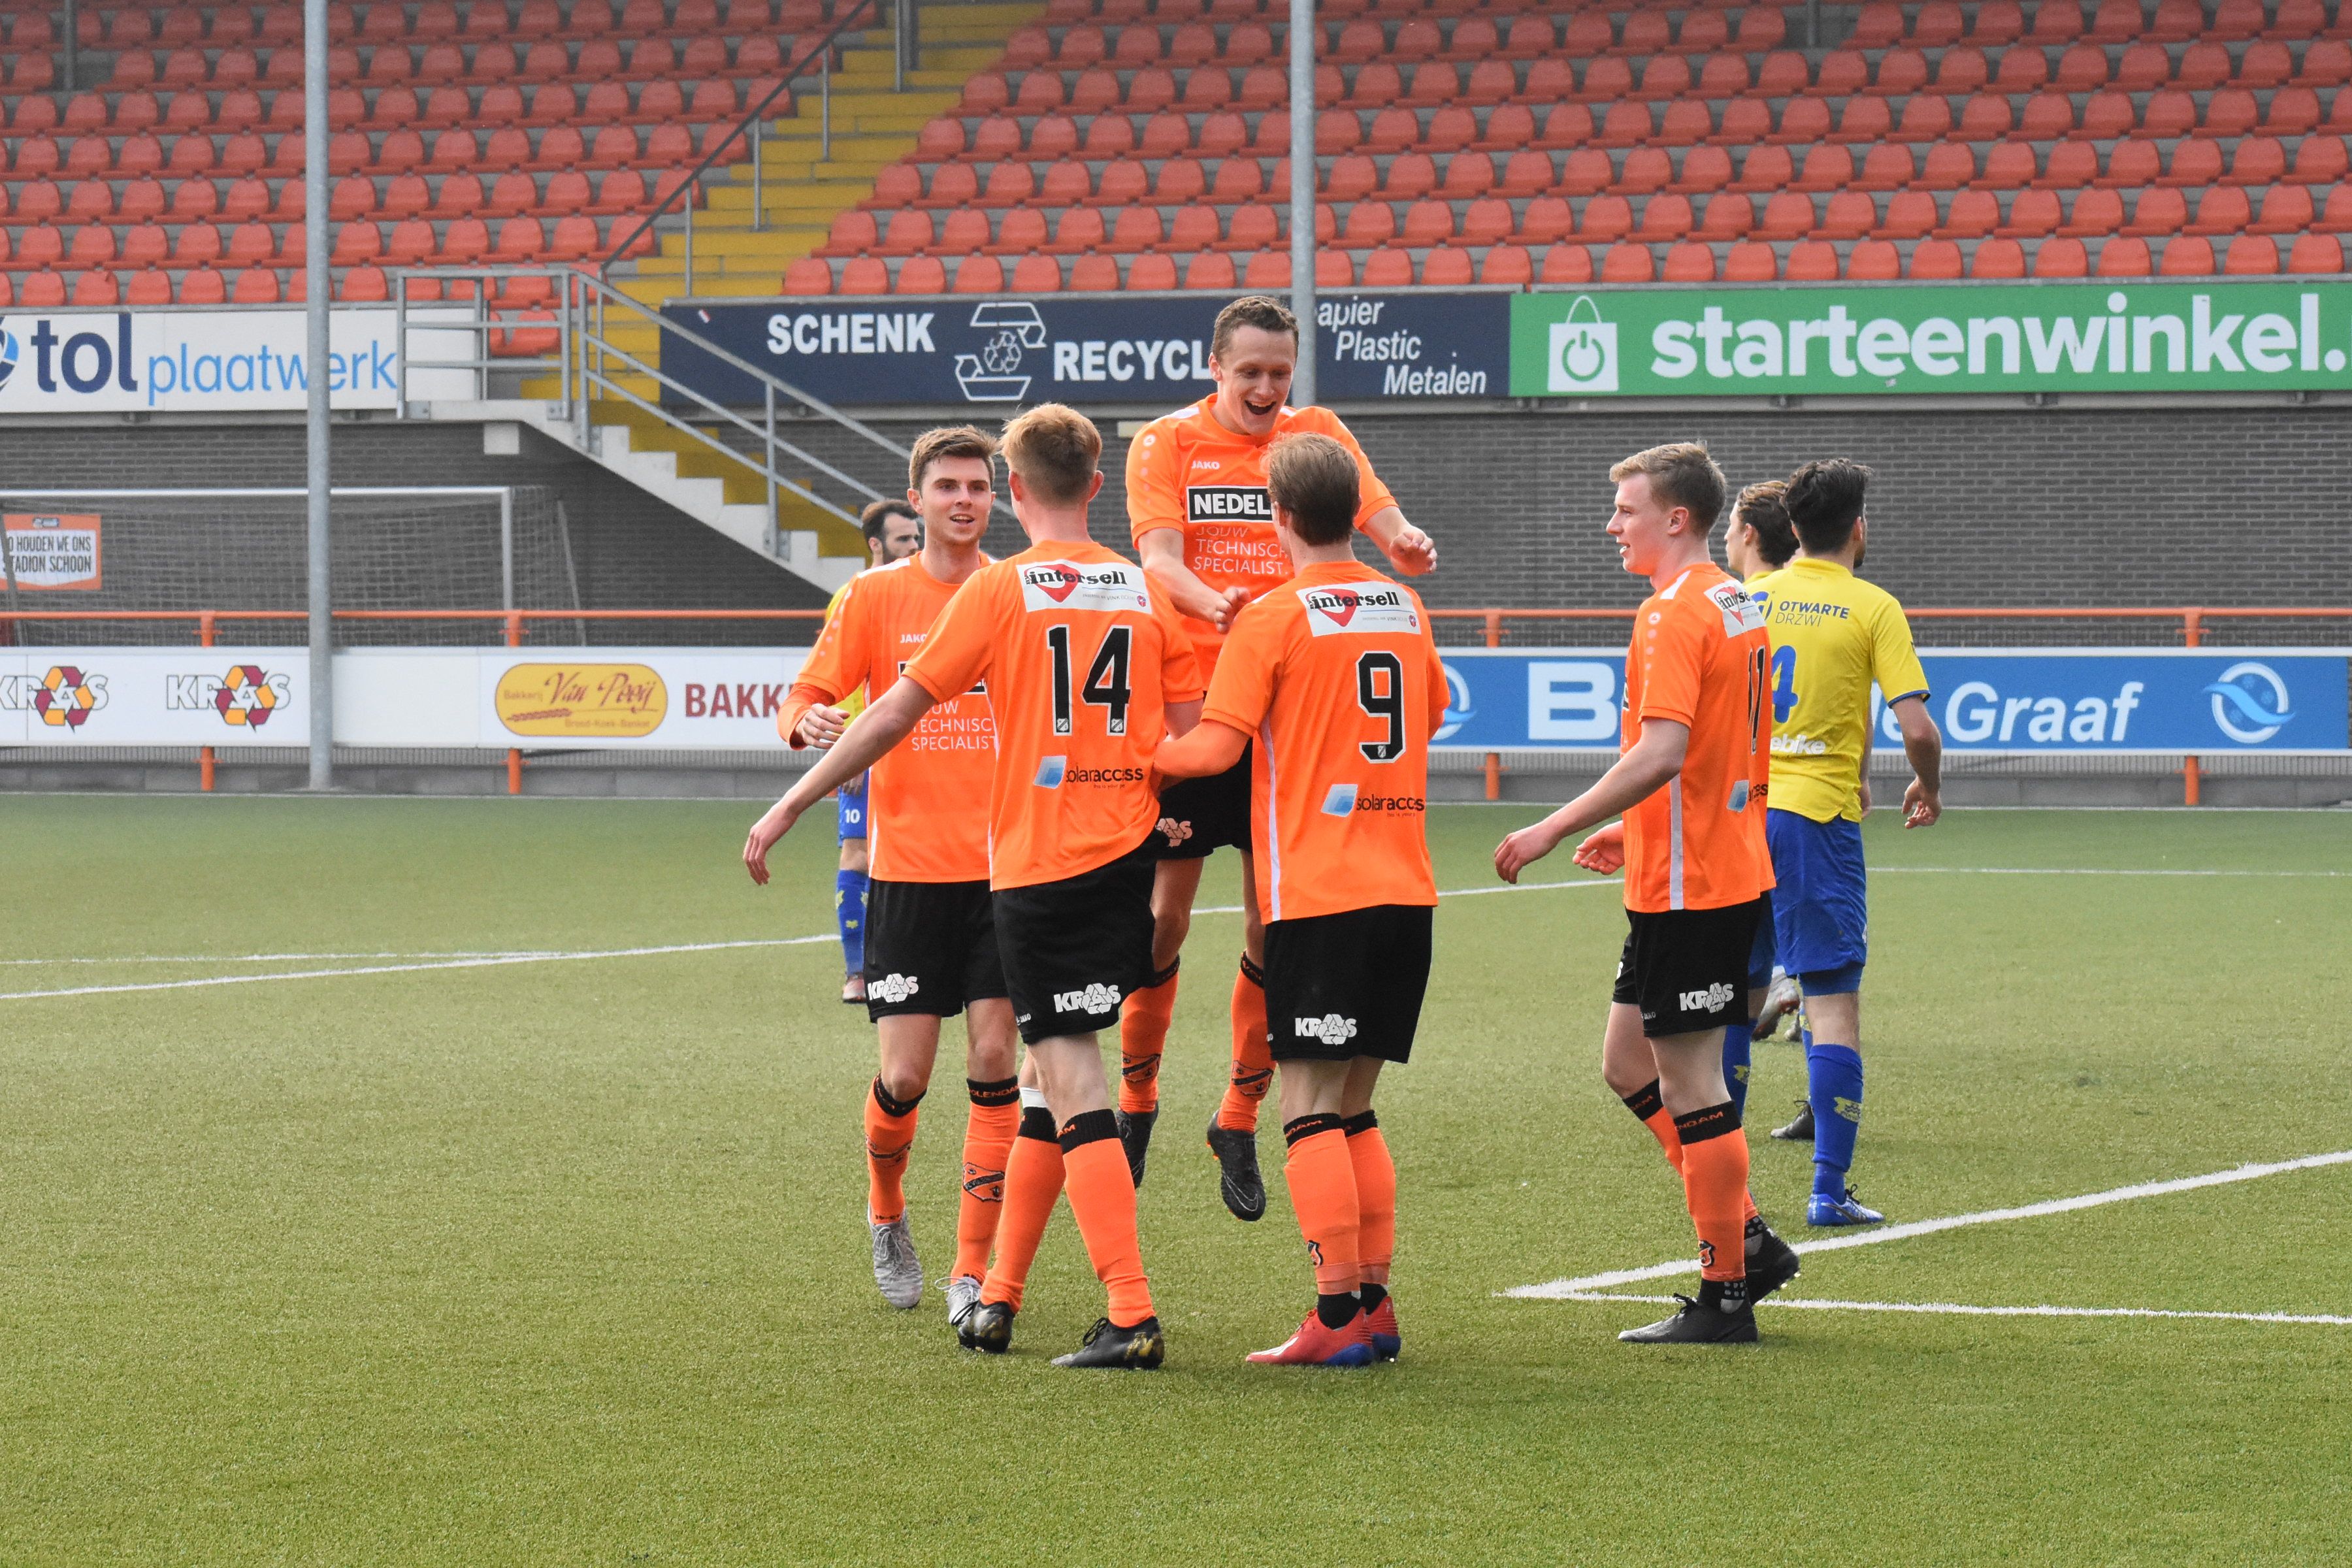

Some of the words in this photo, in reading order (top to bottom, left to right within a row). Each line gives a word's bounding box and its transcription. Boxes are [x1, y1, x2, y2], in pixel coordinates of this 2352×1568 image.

[1316, 295, 1384, 333] apier
[767, 312, 936, 355] SCHENK
[1335, 329, 1422, 361] Plastic
[1650, 291, 2347, 378] starteenwinkel.
[31, 311, 138, 394] tol
[148, 340, 397, 406] plaatwerk
[1053, 339, 1212, 382] RECYCL
[1383, 364, 1487, 395] Metalen
[1191, 461, 1220, 470] JAKO
[1194, 493, 1271, 515] NEDEL
[16, 536, 54, 553] HOUDEN
[57, 536, 69, 552] WE
[72, 536, 91, 553] ONS
[1196, 525, 1249, 538] JOUW
[7, 555, 46, 573] TADION
[49, 555, 91, 573] SCHOON
[1029, 570, 1128, 585] intersell
[1309, 591, 1401, 610] intersell
[1779, 600, 1850, 619] OTWARTE
[1775, 612, 1822, 627] DRZWI
[544, 672, 587, 704] Van
[1047, 624, 1133, 736] 14
[685, 683, 791, 718] BAKK
[1356, 651, 1406, 764] 9
[1945, 681, 2145, 743] Graaf
[913, 717, 992, 733] ECHNISC
[845, 809, 860, 824] 10
